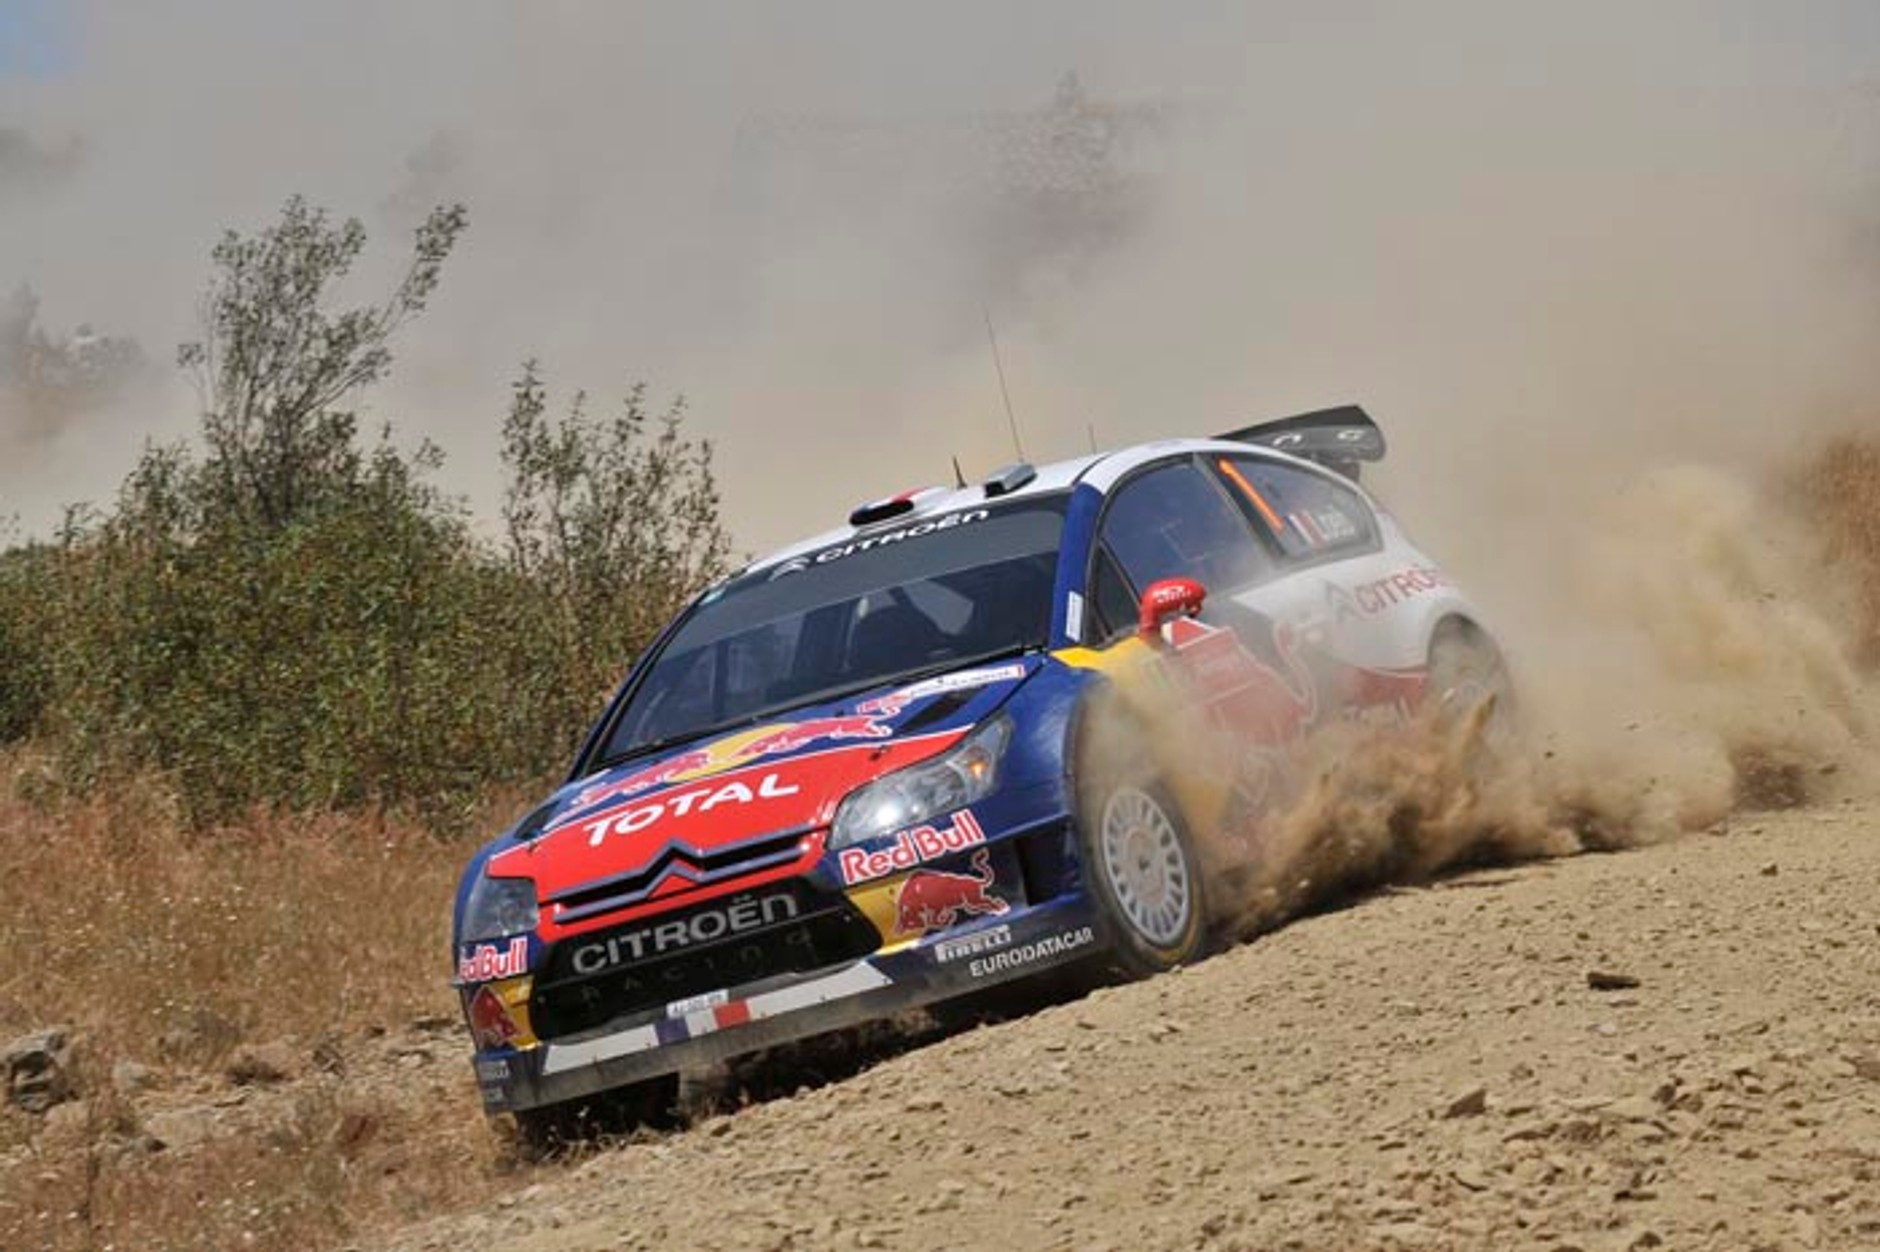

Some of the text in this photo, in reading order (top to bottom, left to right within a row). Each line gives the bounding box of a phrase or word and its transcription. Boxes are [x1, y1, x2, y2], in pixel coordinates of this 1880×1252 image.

[582, 773, 799, 847] TOTAL
[839, 808, 987, 885] Red Bull
[969, 926, 1095, 978] EURODATACAR
